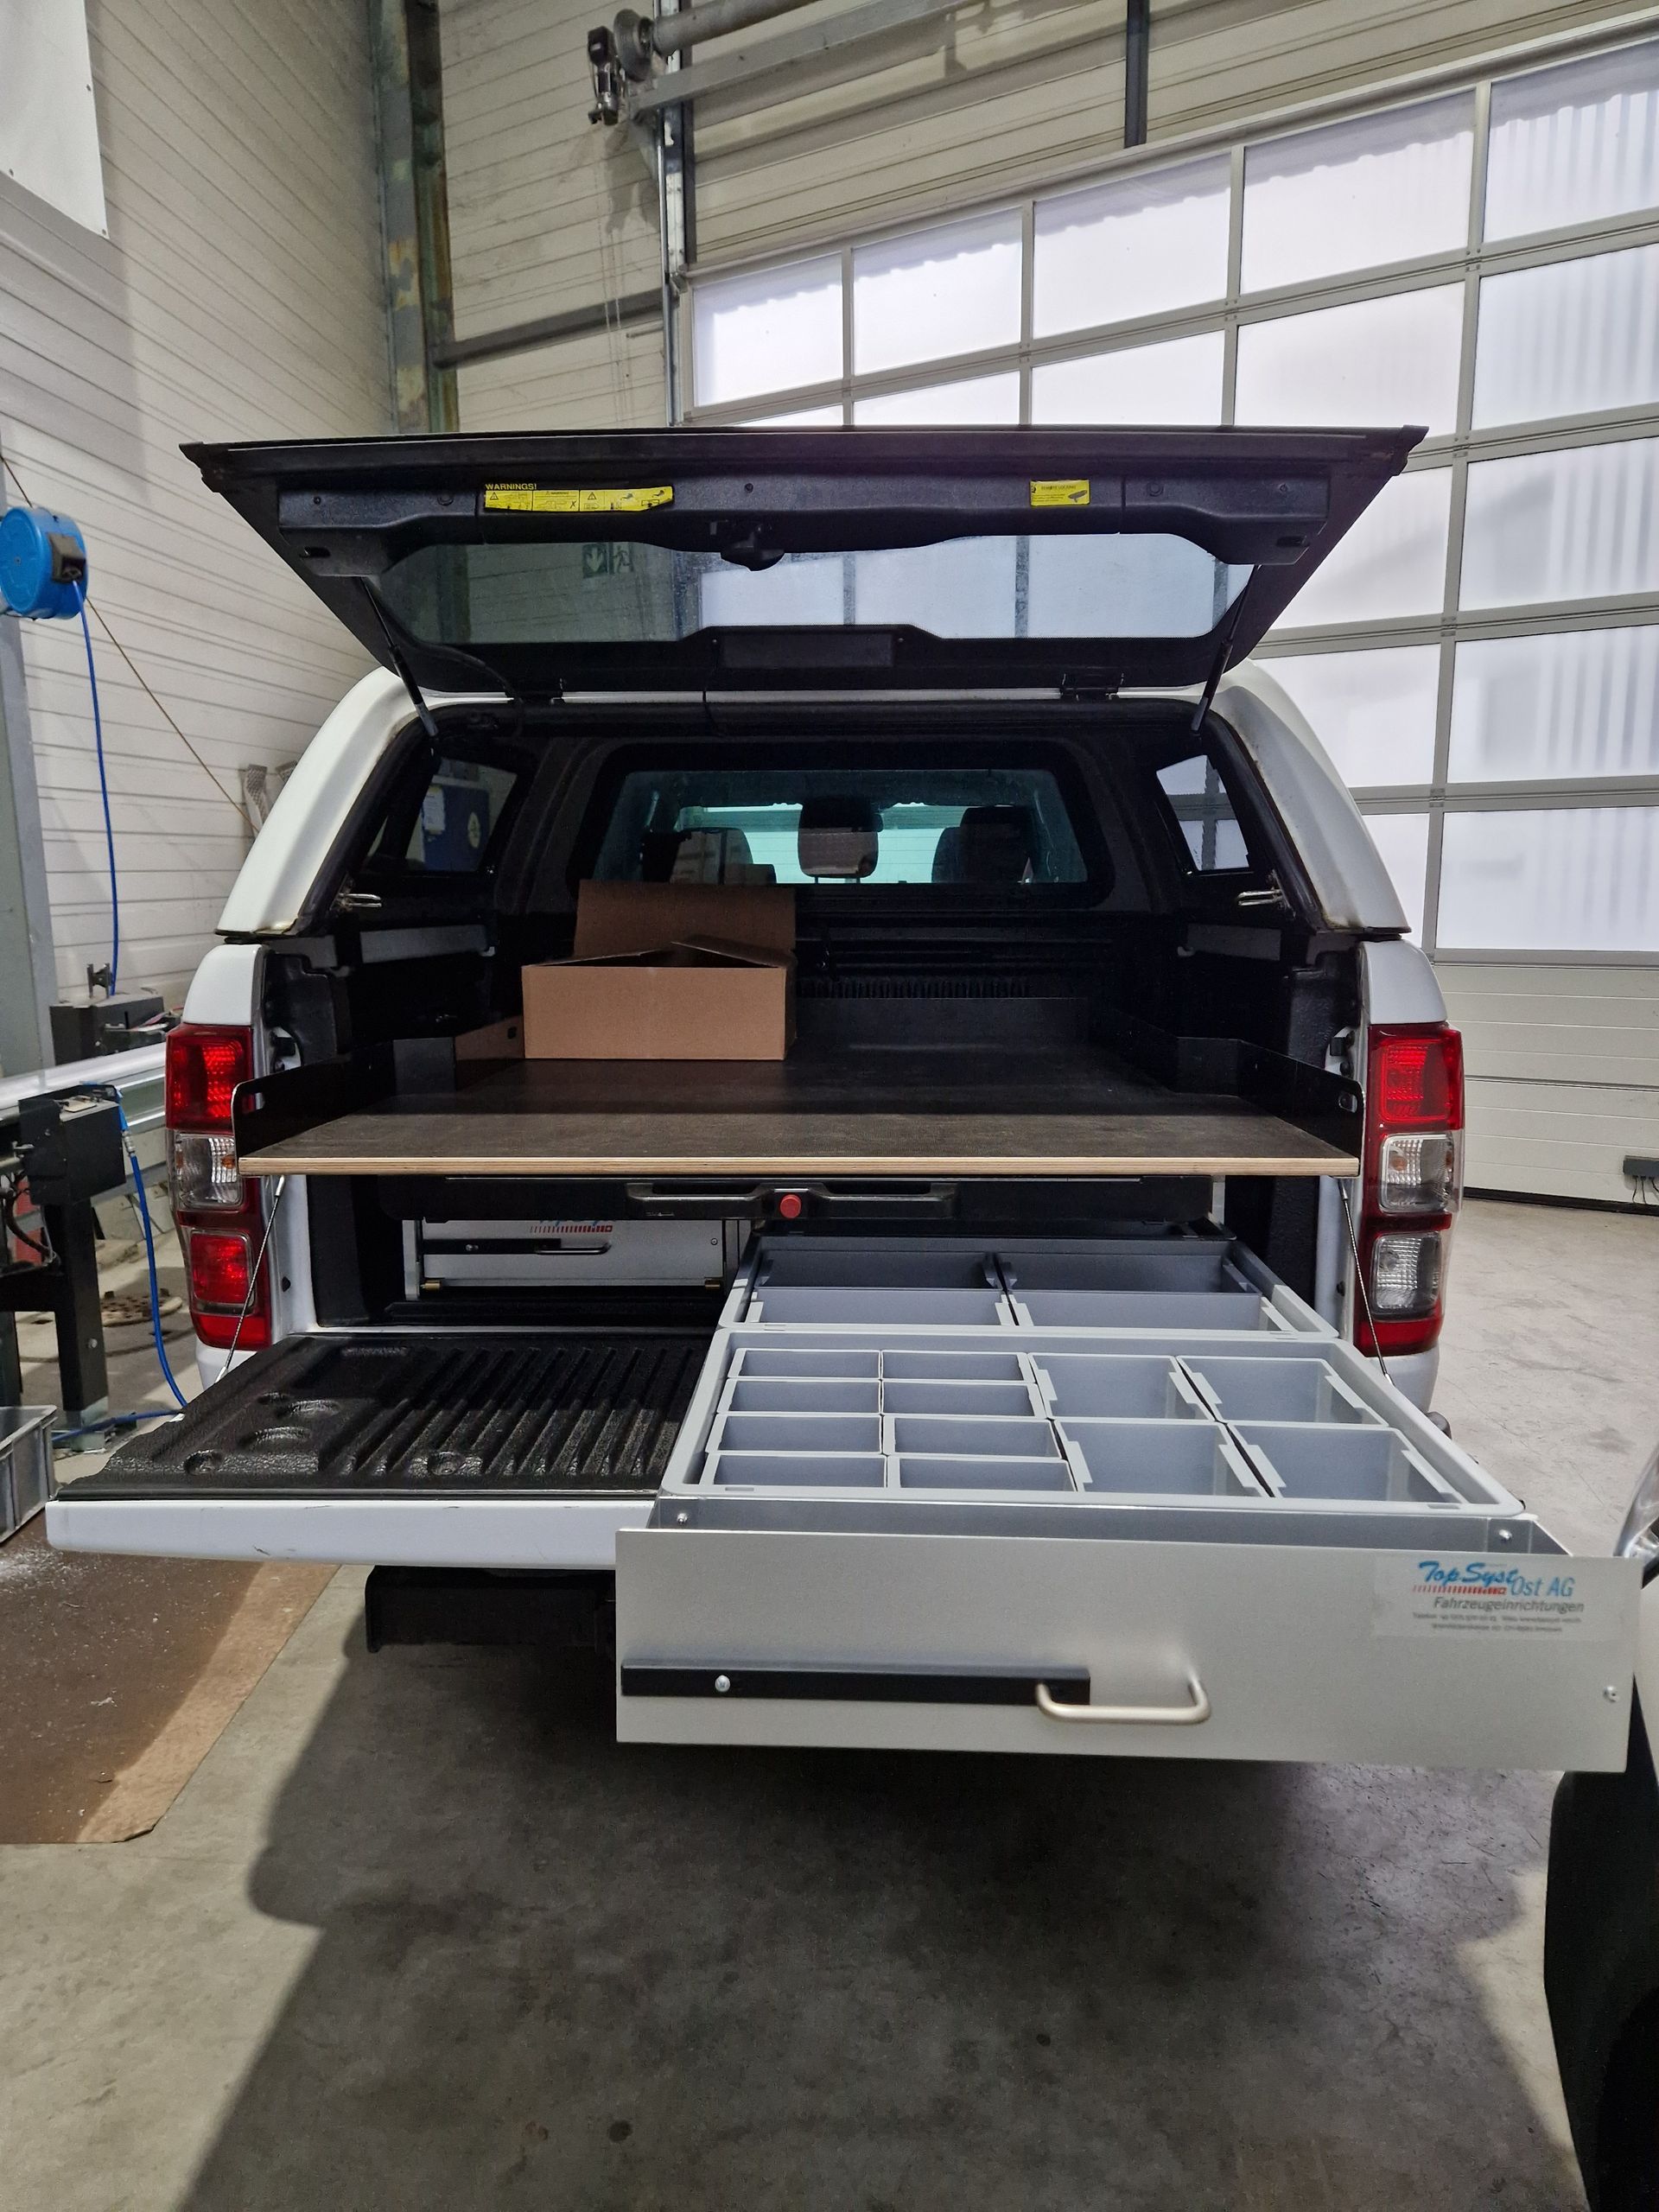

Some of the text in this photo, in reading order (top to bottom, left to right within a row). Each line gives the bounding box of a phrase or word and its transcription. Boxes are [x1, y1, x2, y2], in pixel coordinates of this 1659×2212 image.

[485, 482, 537, 491] WARNINGS!
[1510, 1576, 1543, 1597] Ost
[1547, 1576, 1575, 1598] AG
[1433, 1596, 1585, 1614] Fahrzeugeinrichtungen
